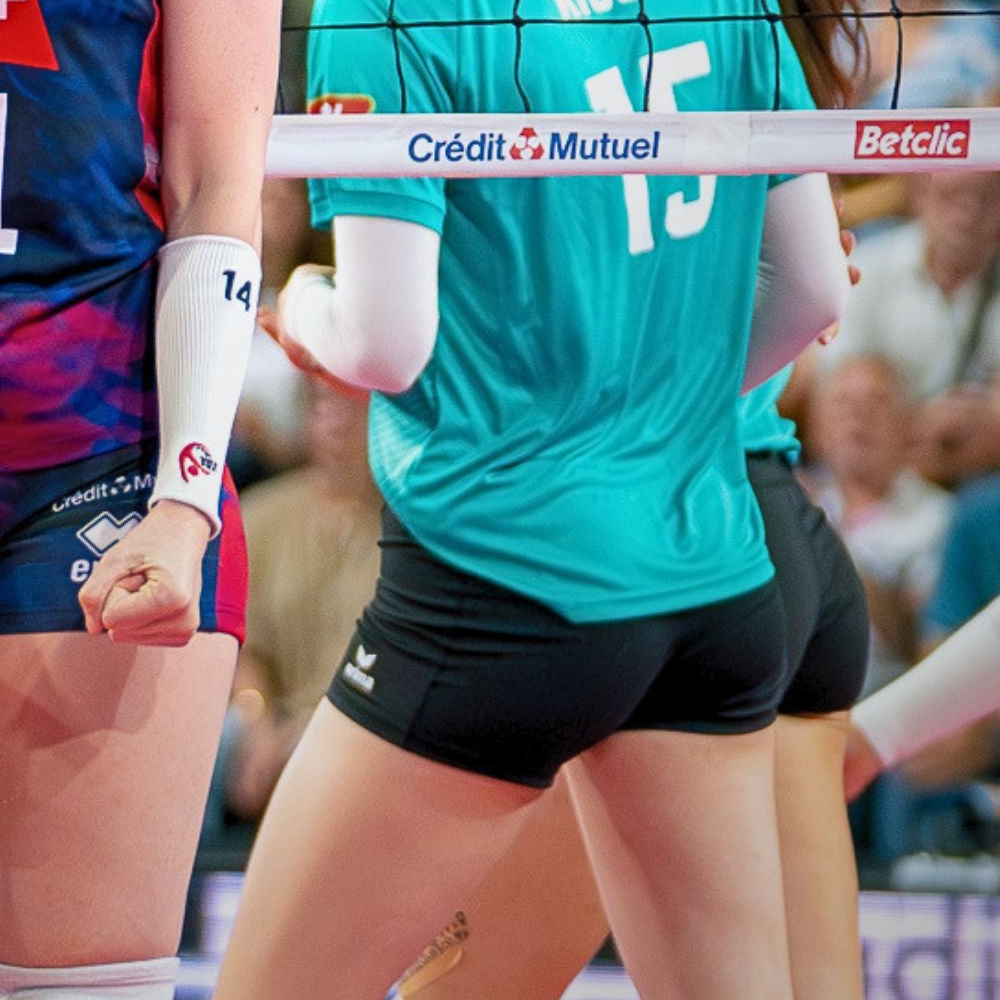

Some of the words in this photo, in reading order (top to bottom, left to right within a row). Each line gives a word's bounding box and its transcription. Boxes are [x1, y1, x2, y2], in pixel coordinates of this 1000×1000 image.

[408, 133, 507, 163] Crédit
[549, 131, 661, 160] Mutuel
[584, 40, 712, 256] 15
[857, 122, 967, 156] Betclic
[222, 269, 252, 312] 14
